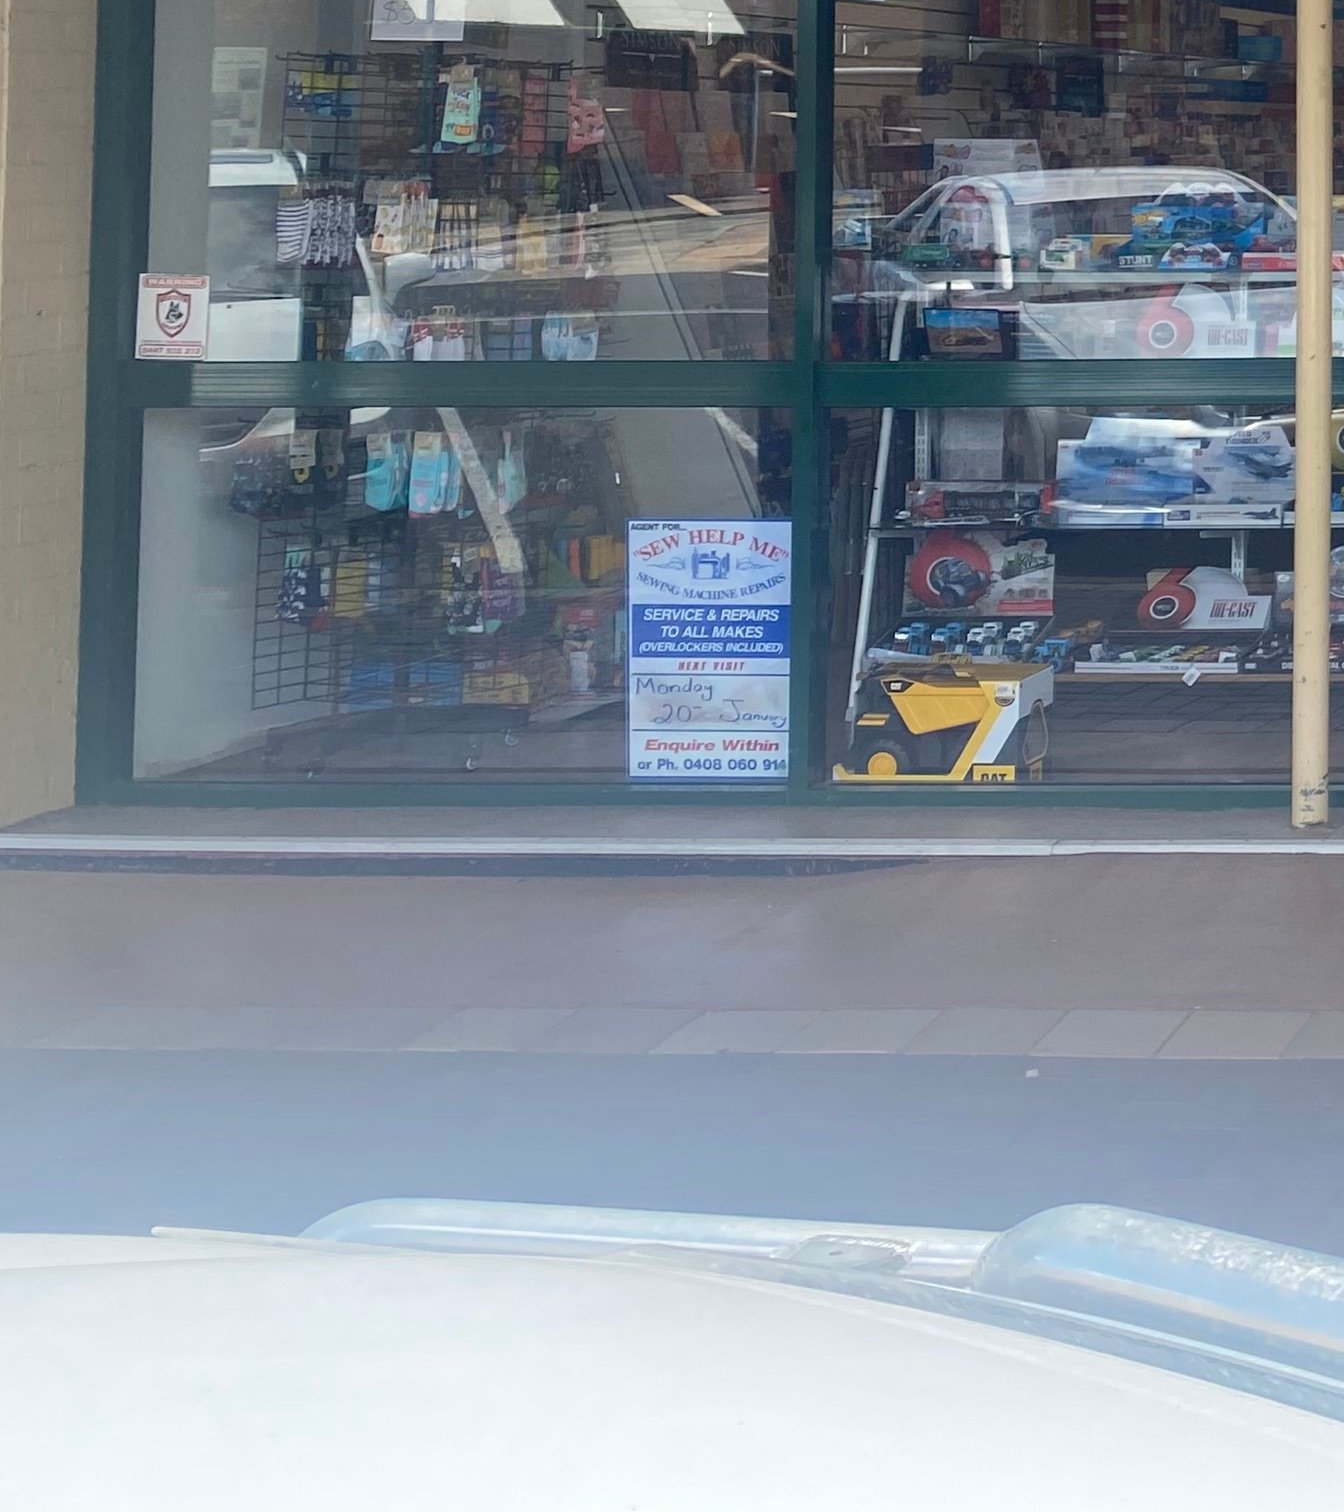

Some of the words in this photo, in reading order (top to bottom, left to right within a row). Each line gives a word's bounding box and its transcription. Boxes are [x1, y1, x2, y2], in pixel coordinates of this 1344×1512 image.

[1118, 256, 1152, 267] STUNT
[1208, 327, 1249, 346] DIE-CAST
[630, 523, 660, 531] AGENT
[688, 528, 745, 547] HELP
[636, 571, 682, 597] SEWING
[682, 584, 738, 600] MACHINE
[740, 573, 786, 597] REPAIRS
[643, 608, 702, 622] SERVICE
[707, 609, 717, 621] &
[720, 609, 779, 622] REPAIRS
[1210, 601, 1258, 619] DIE-CAST
[661, 626, 680, 638] TO
[682, 626, 708, 638] ALL
[712, 626, 763, 638] MAKES
[639, 641, 722, 654] (OVERLOCKERS
[726, 642, 783, 654] INCLUDED)
[678, 661, 708, 671] NEXT
[713, 661, 745, 671] VISIT
[635, 677, 713, 701] Monday
[719, 699, 787, 728] January
[644, 739, 715, 754] Enquire
[722, 739, 779, 752] Within
[637, 760, 652, 770] or
[657, 759, 678, 771] Ph.
[684, 759, 722, 771] 0408
[728, 759, 758, 771] 060
